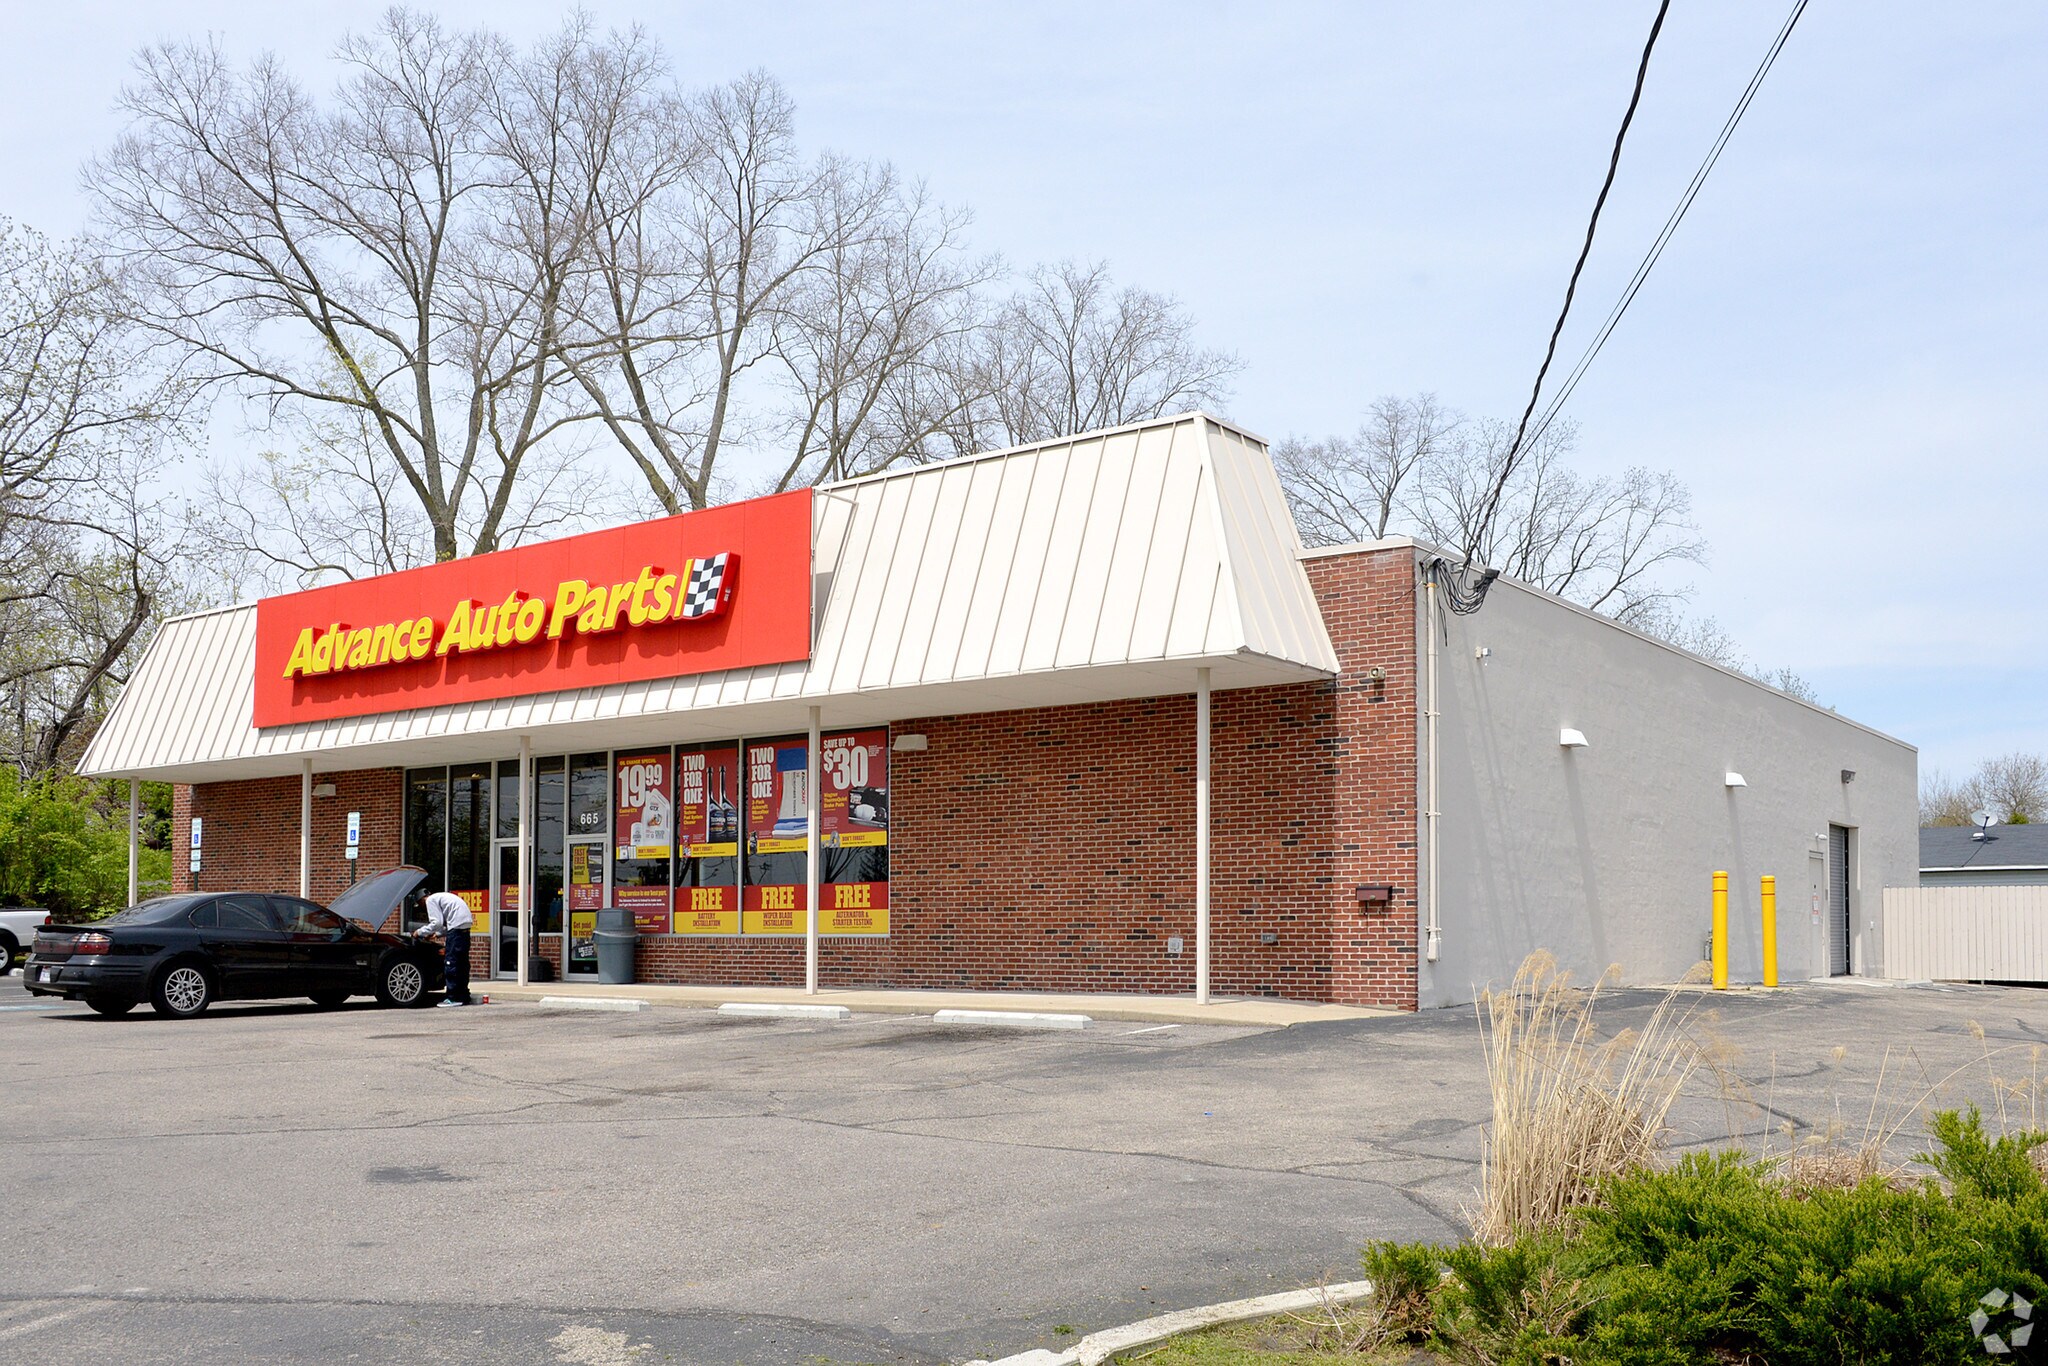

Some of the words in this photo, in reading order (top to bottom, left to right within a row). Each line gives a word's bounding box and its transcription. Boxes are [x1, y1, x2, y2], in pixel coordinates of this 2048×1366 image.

[283, 615, 434, 680] Advance
[437, 592, 546, 656] Auto
[548, 566, 676, 639] Parts
[823, 739, 838, 750] SAVE
[838, 738, 847, 748] UP
[848, 737, 855, 747] TO
[683, 754, 705, 772] TWO
[750, 747, 774, 764] TWO
[751, 764, 772, 782] FOR
[823, 745, 869, 790] $30
[683, 771, 703, 788] FOR
[683, 788, 704, 805] ONE
[751, 781, 772, 799] ONE
[580, 812, 599, 825] 665
[691, 888, 723, 910] FREE
[761, 886, 795, 909] FREE
[834, 884, 871, 908] FREE
[692, 919, 721, 927] INSTALLATION
[763, 919, 793, 927] INSTALLATION
[835, 911, 864, 919] ALTERNATOR
[853, 918, 873, 926] TESTING
[573, 921, 581, 929] Get
[581, 921, 592, 931] paid
[579, 929, 593, 938] recycl
